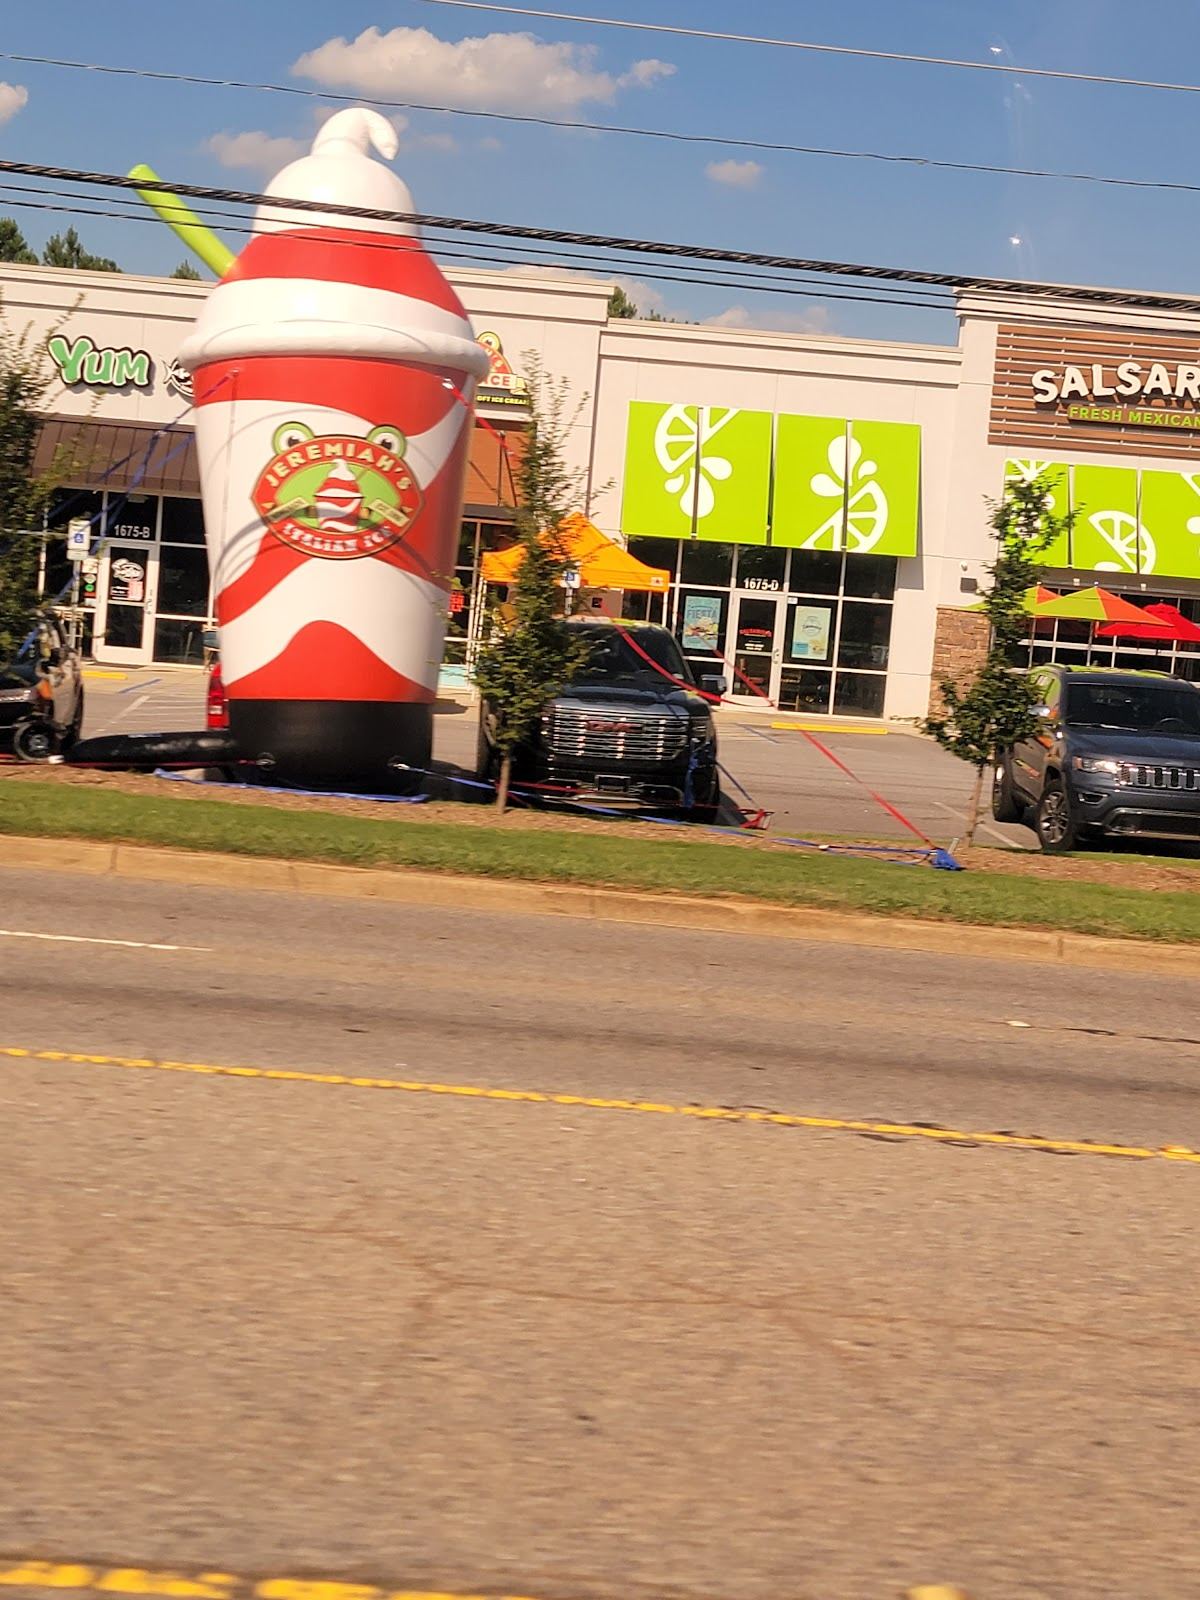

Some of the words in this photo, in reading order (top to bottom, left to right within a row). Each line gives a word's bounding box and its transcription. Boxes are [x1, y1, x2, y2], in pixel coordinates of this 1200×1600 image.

[1069, 406, 1122, 421] FRESH
[265, 442, 412, 490] JEREMIAH'S
[114, 524, 151, 539] 1675-B
[743, 577, 779, 591] 1675-D
